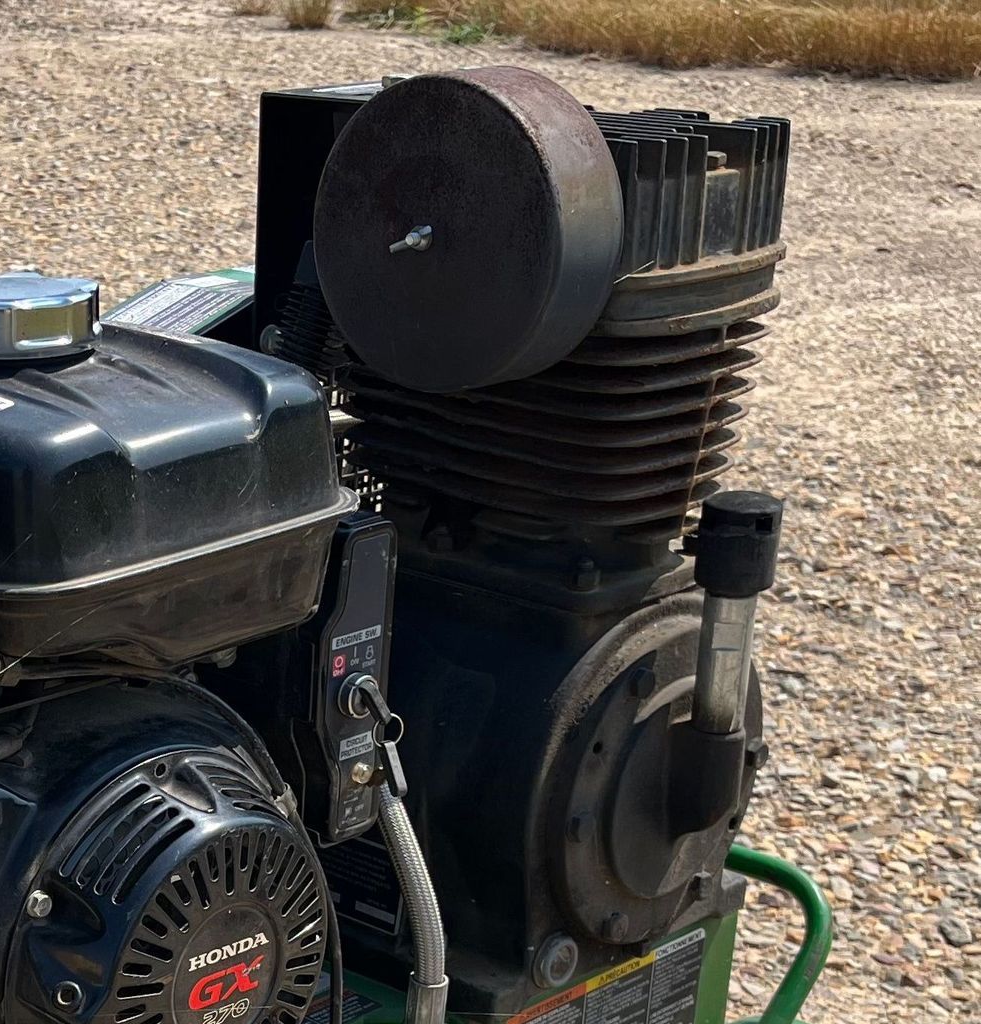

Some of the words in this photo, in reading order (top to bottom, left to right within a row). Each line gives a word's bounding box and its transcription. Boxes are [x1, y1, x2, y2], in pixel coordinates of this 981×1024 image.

[336, 632, 363, 647] ENGINE
[341, 742, 372, 758] PROTECTOR
[346, 734, 368, 748] CIRCUIT
[188, 932, 269, 972] HONDA
[656, 931, 703, 957] FONCTIONNEMENT
[188, 954, 265, 1010] GX
[527, 991, 572, 1018] ERTISSEMENT
